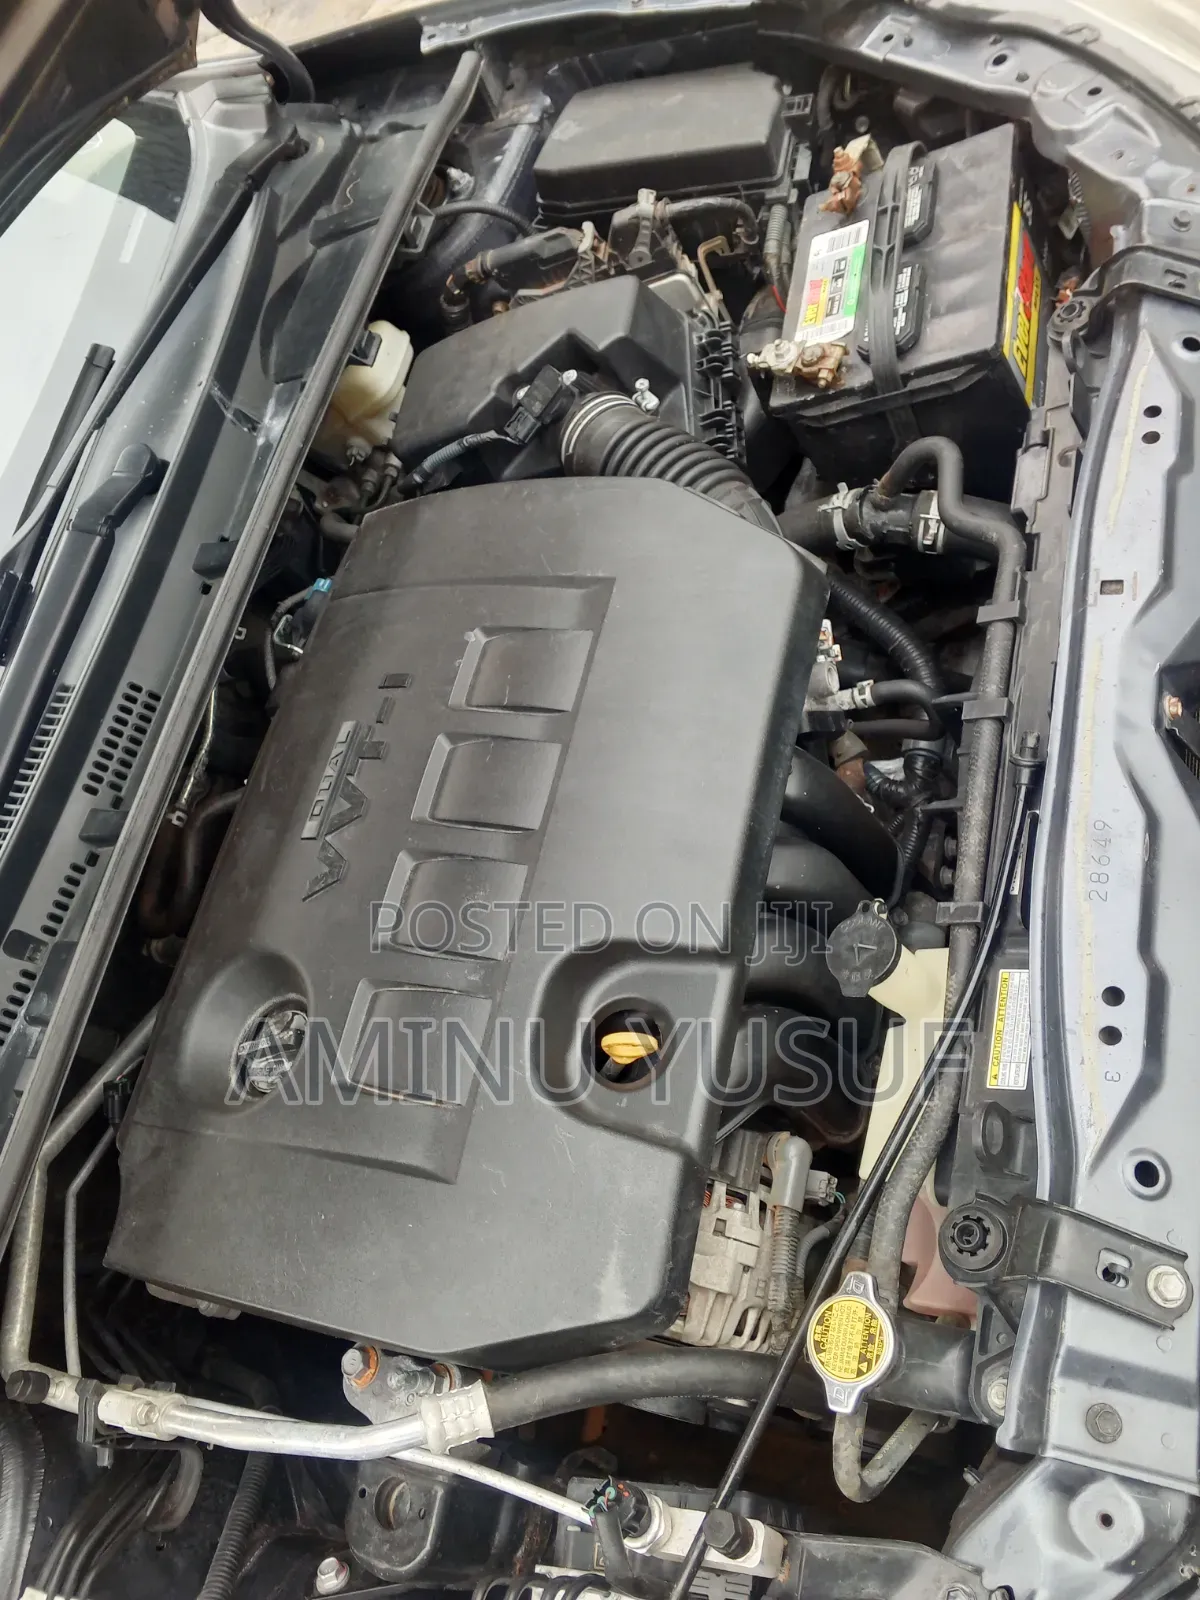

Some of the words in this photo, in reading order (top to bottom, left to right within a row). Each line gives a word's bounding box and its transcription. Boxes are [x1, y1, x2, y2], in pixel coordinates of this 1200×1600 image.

[308, 726, 351, 820] DUAL
[1086, 818, 1114, 902] 28649
[997, 976, 1009, 1022] ATTENTION
[992, 1029, 1003, 1067] CAUTION
[819, 1309, 832, 1350] CAUTION
[833, 1334, 841, 1351] OPEN
[859, 1311, 872, 1354] ATTENTION
